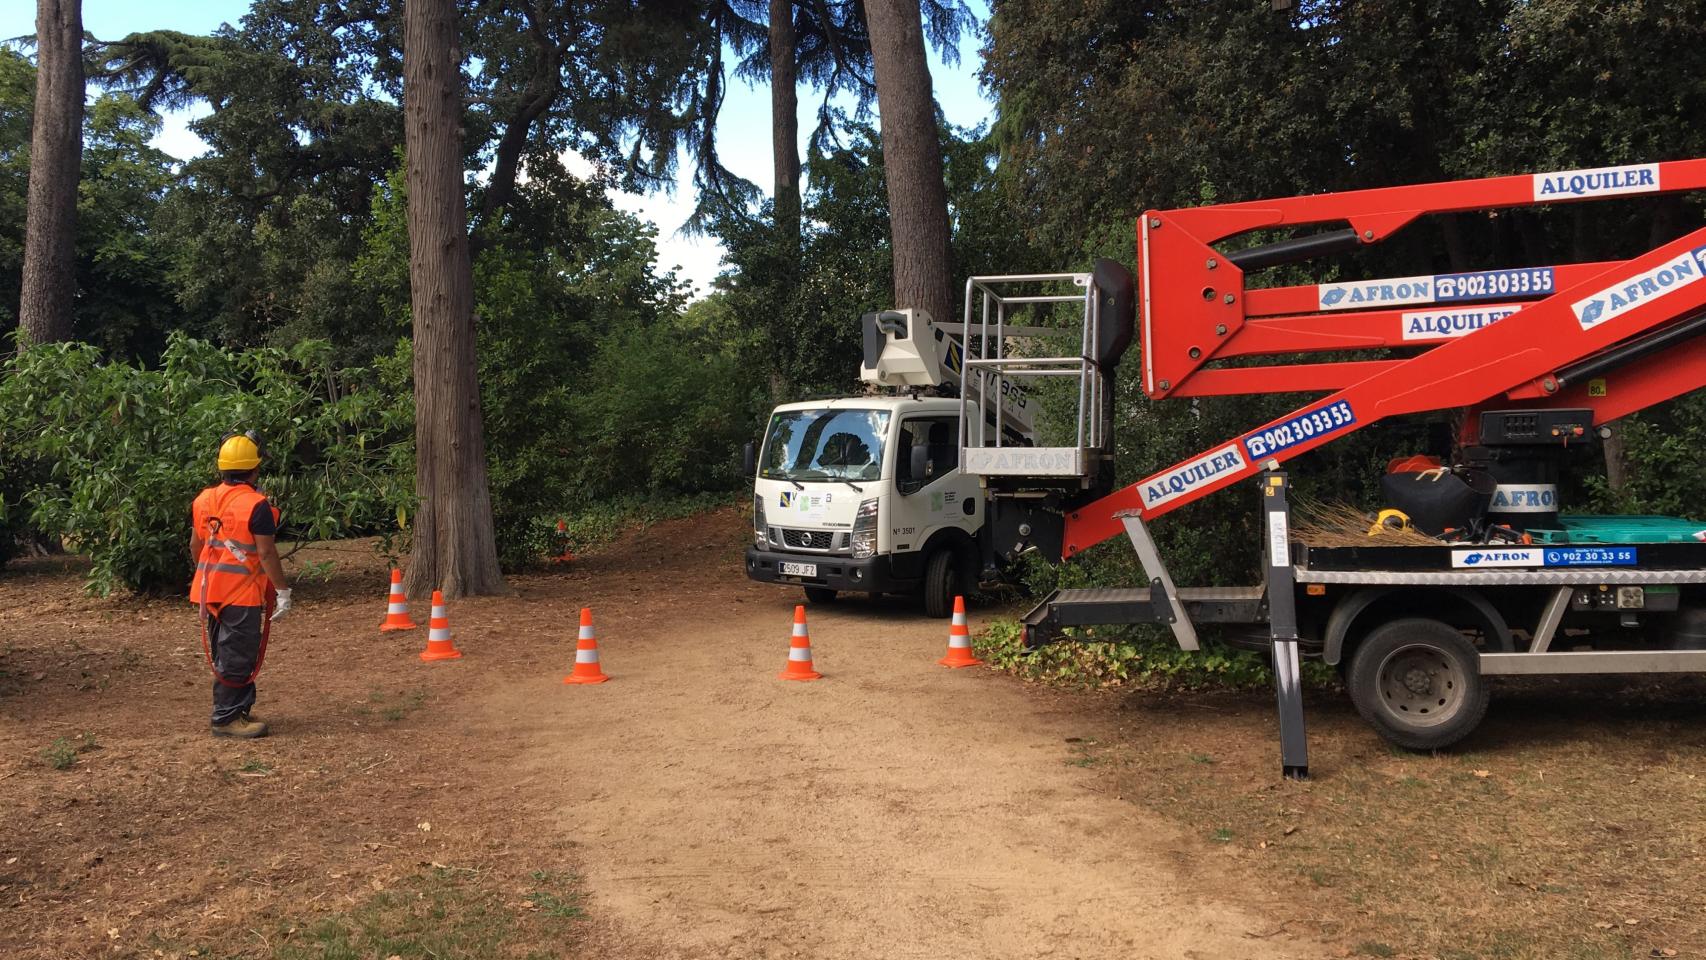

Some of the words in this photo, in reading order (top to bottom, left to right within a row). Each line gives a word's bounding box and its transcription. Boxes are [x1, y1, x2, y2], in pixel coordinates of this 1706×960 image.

[1540, 168, 1655, 195] ALQUILER
[1349, 282, 1429, 303] AFRON
[1609, 259, 1694, 311] AFRON
[995, 453, 1071, 470] AFRON
[1147, 450, 1240, 503] ALQUILER
[1493, 490, 1556, 507] AFRO
[1484, 552, 1530, 562] AFRON
[1562, 552, 1582, 561] 902
[1585, 552, 1598, 561] 30
[1601, 552, 1614, 560] 33
[1618, 551, 1631, 560] 55
